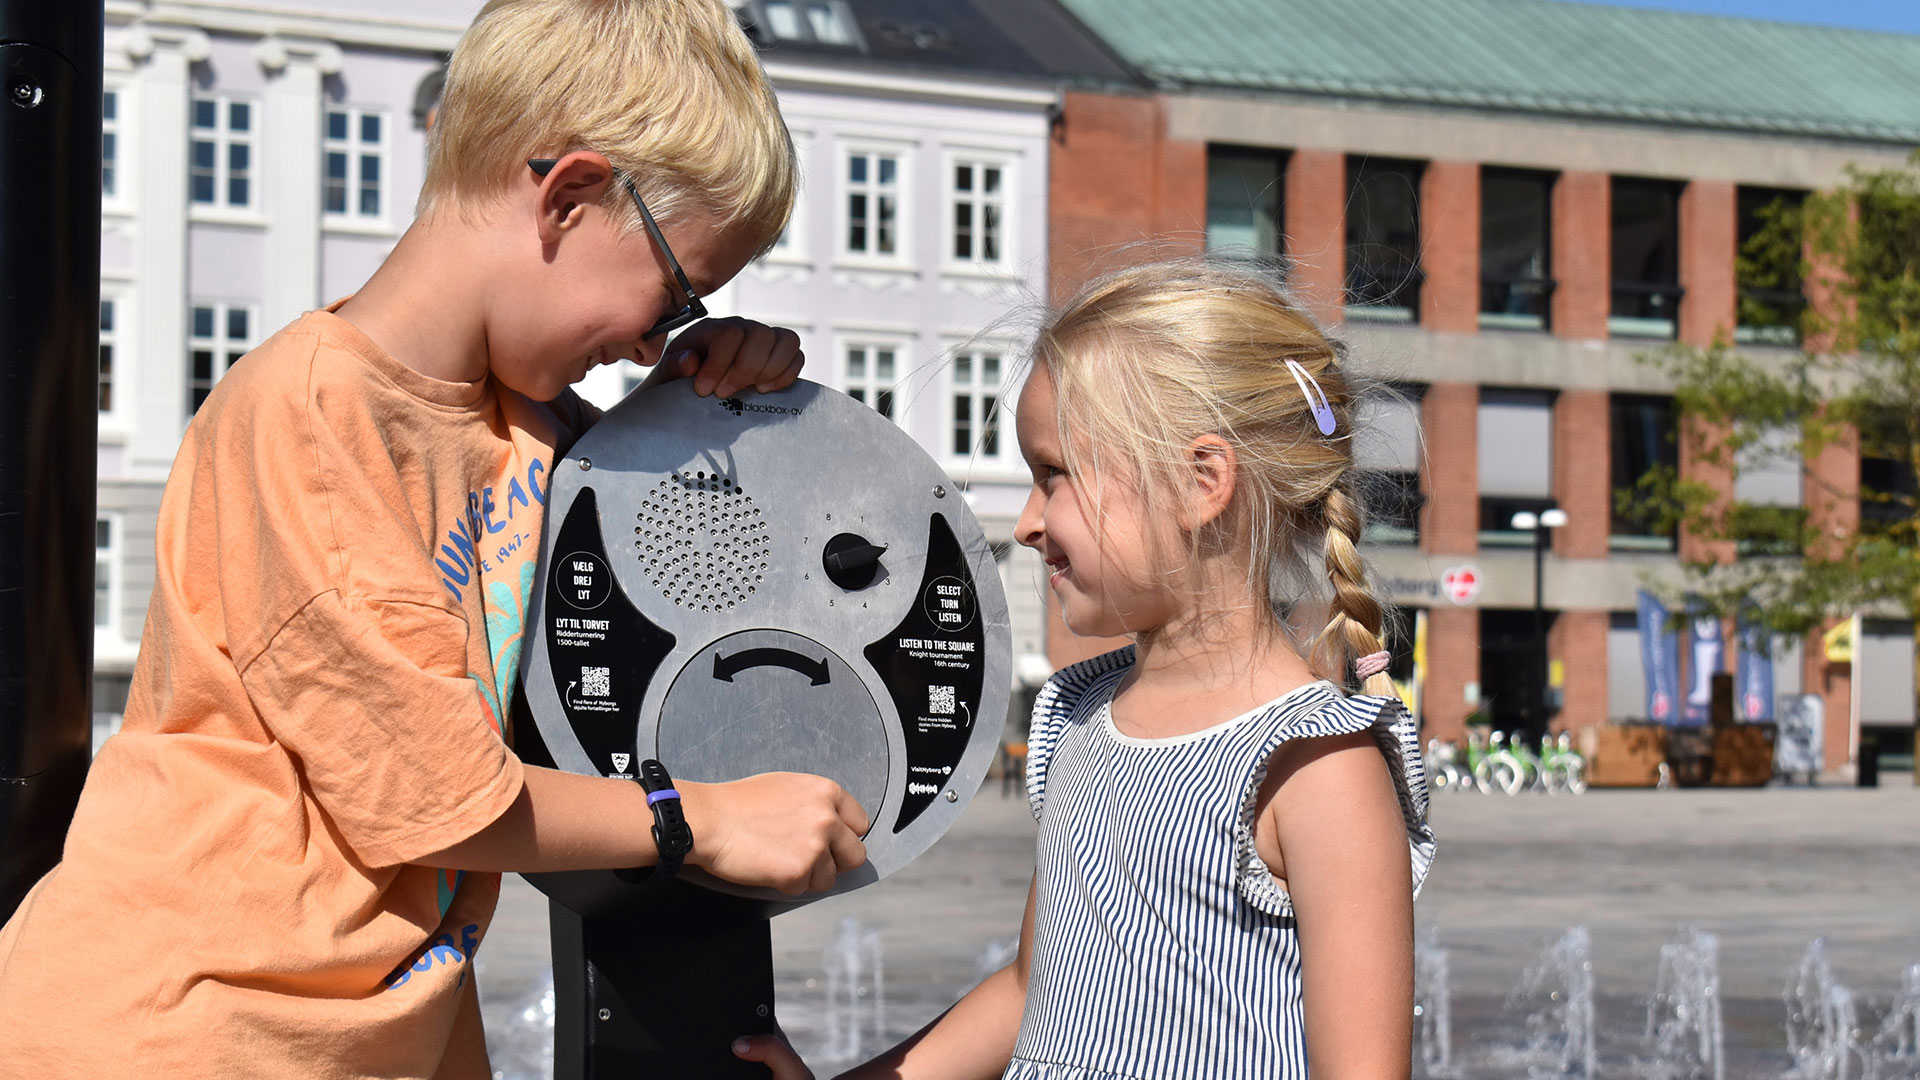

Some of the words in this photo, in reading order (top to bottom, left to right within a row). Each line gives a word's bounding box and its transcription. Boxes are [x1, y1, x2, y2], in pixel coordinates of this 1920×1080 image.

[825, 513, 832, 521] 8
[803, 537, 809, 545] 7
[573, 561, 594, 572] VÆLG
[573, 575, 592, 586] DREJ
[804, 572, 810, 580] 6
[578, 590, 590, 600] LYT
[936, 585, 961, 596] SELECT
[829, 599, 835, 607] 5
[861, 601, 868, 609] 4
[940, 599, 959, 609] TURN
[938, 613, 962, 623] LISTEN
[556, 618, 568, 628] LYT
[569, 618, 581, 629] TIL
[582, 619, 610, 631] TORVET
[557, 639, 590, 647] 1500-tallet
[899, 638, 923, 649] LISTEN
[923, 640, 933, 650] TO
[933, 641, 947, 651] THE
[947, 641, 975, 652] SQUARE
[909, 650, 929, 659] Knight
[928, 652, 963, 660] tournament
[934, 660, 947, 668] 16th
[947, 662, 970, 670] century
